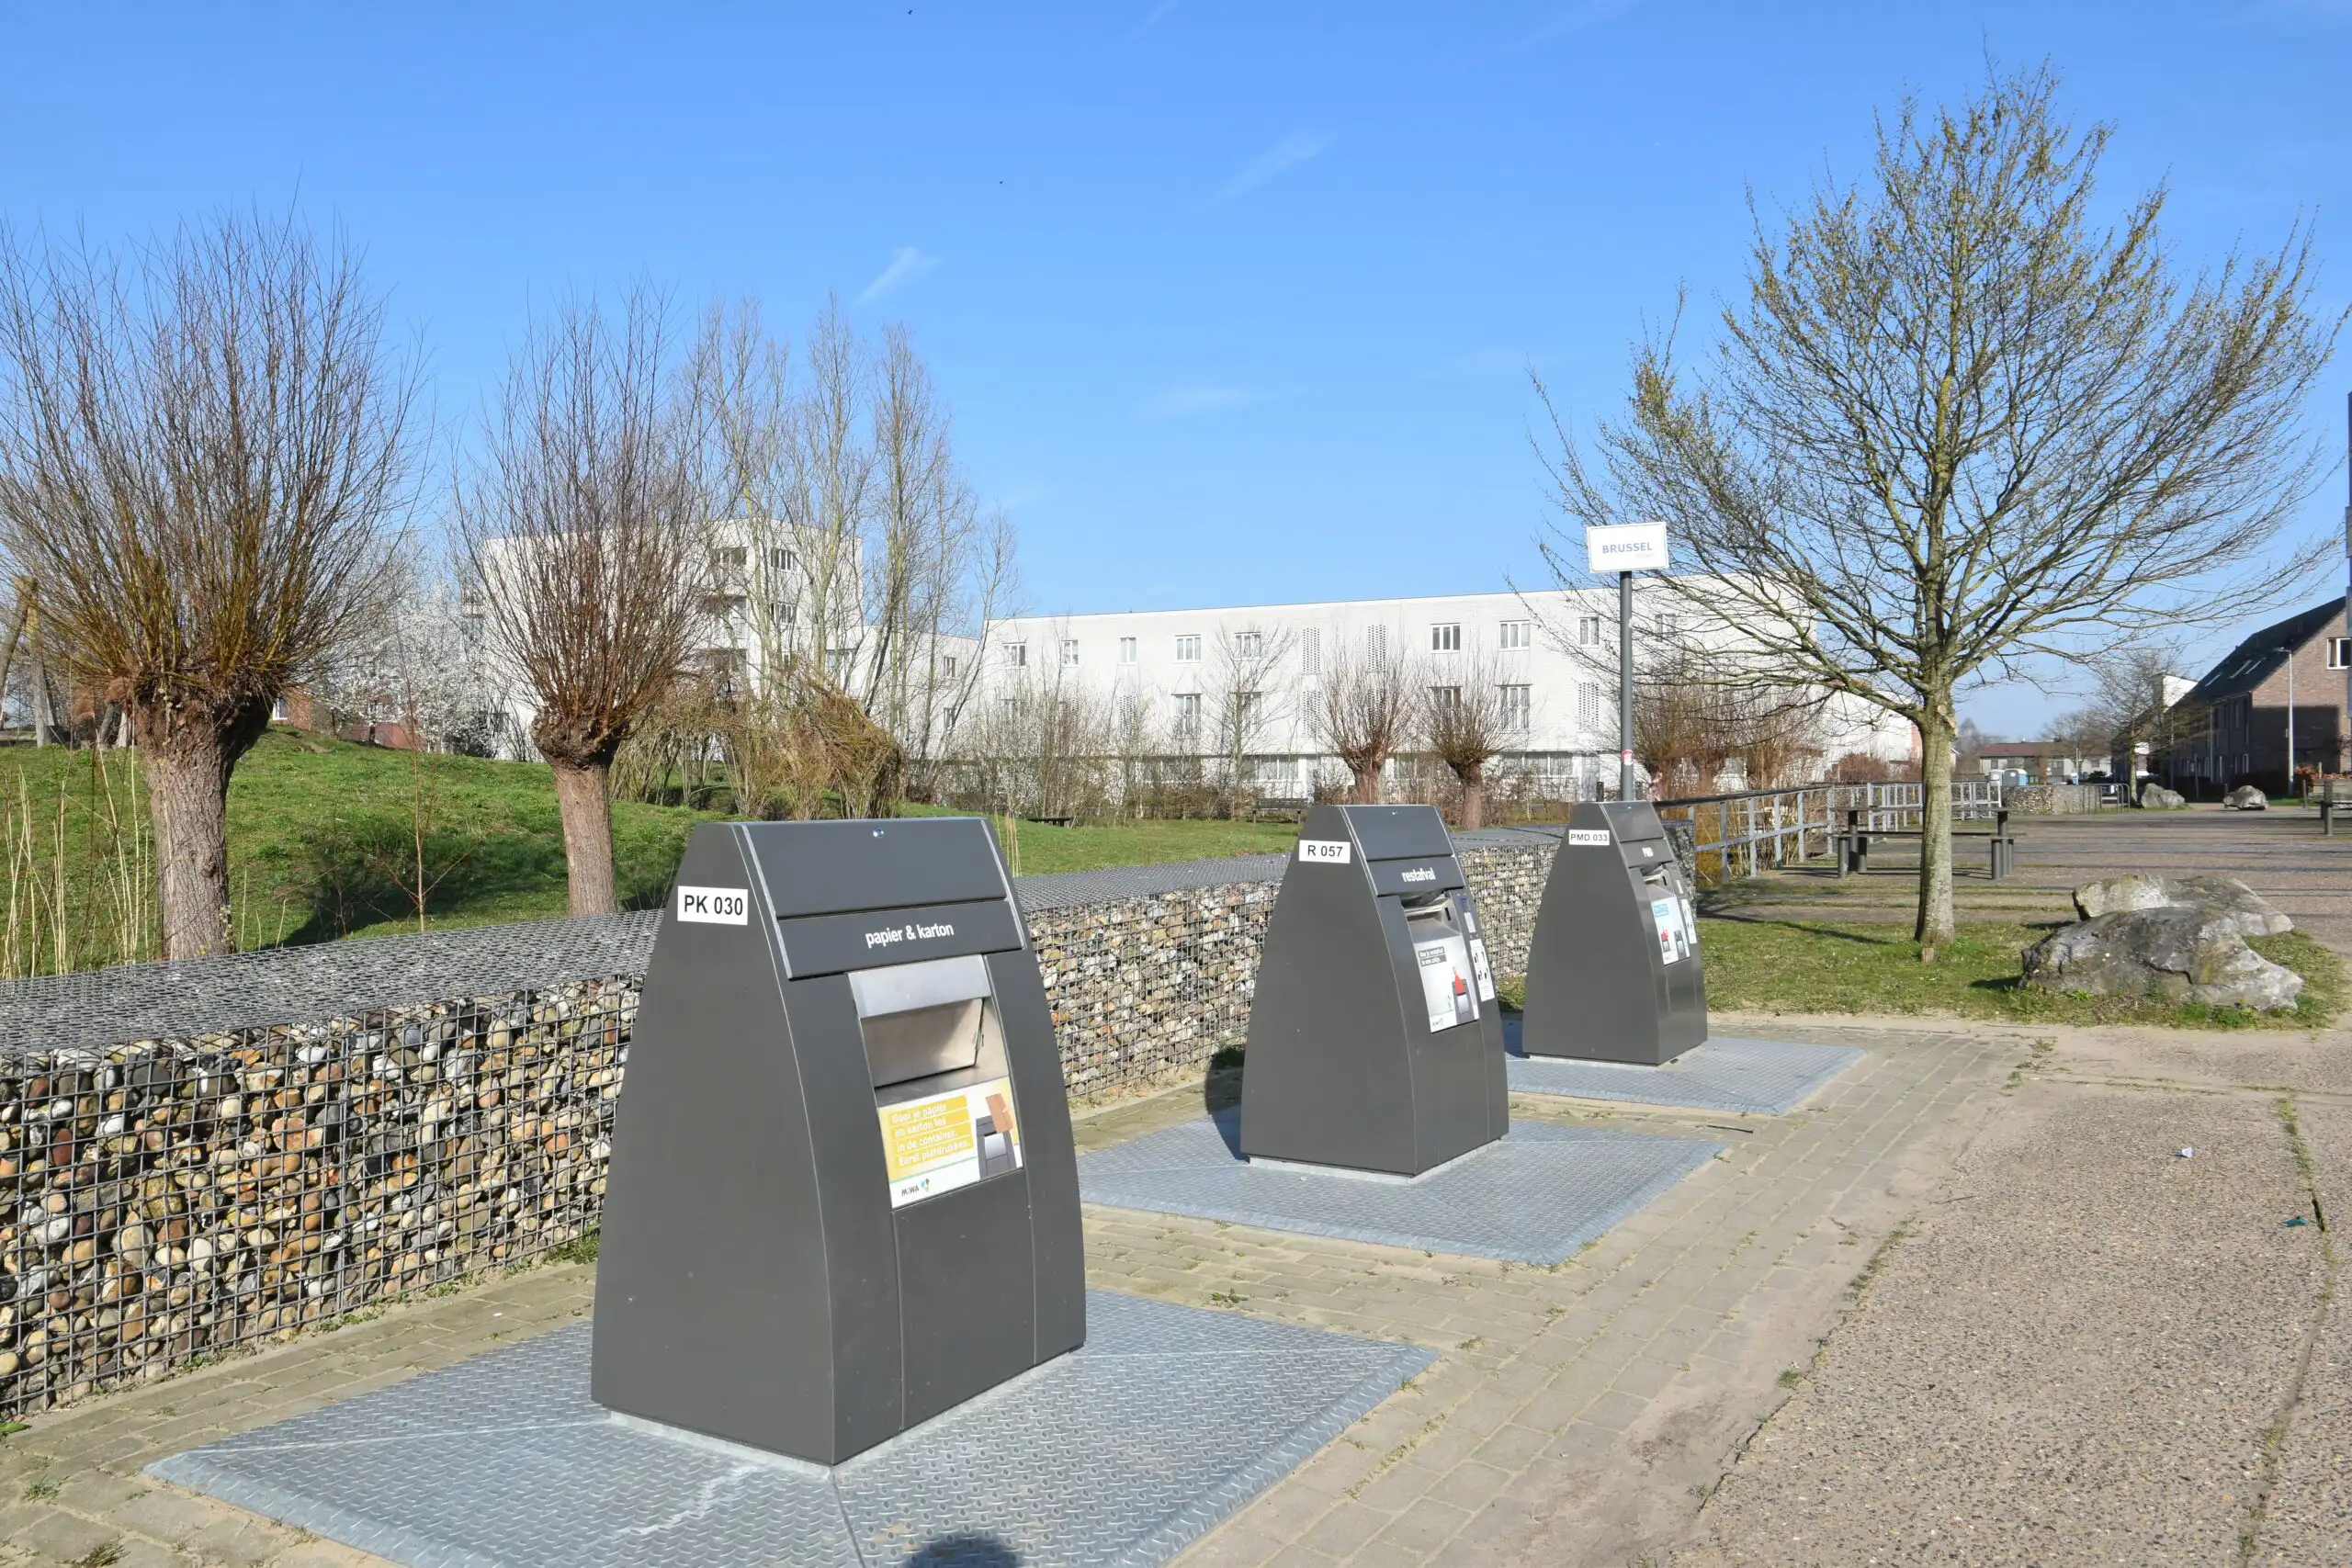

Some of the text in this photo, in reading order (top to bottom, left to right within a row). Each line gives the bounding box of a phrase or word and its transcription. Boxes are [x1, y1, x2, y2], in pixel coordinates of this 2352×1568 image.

[1602, 542, 1653, 553] BRUSSEL
[1570, 833, 1590, 841] PMD
[1307, 845, 1343, 857] R 057
[1401, 867, 1436, 883] restafval
[684, 894, 743, 916] PK 030
[865, 922, 955, 949] papier & karton
[923, 1104, 946, 1118] papier
[908, 1122, 932, 1133] karton
